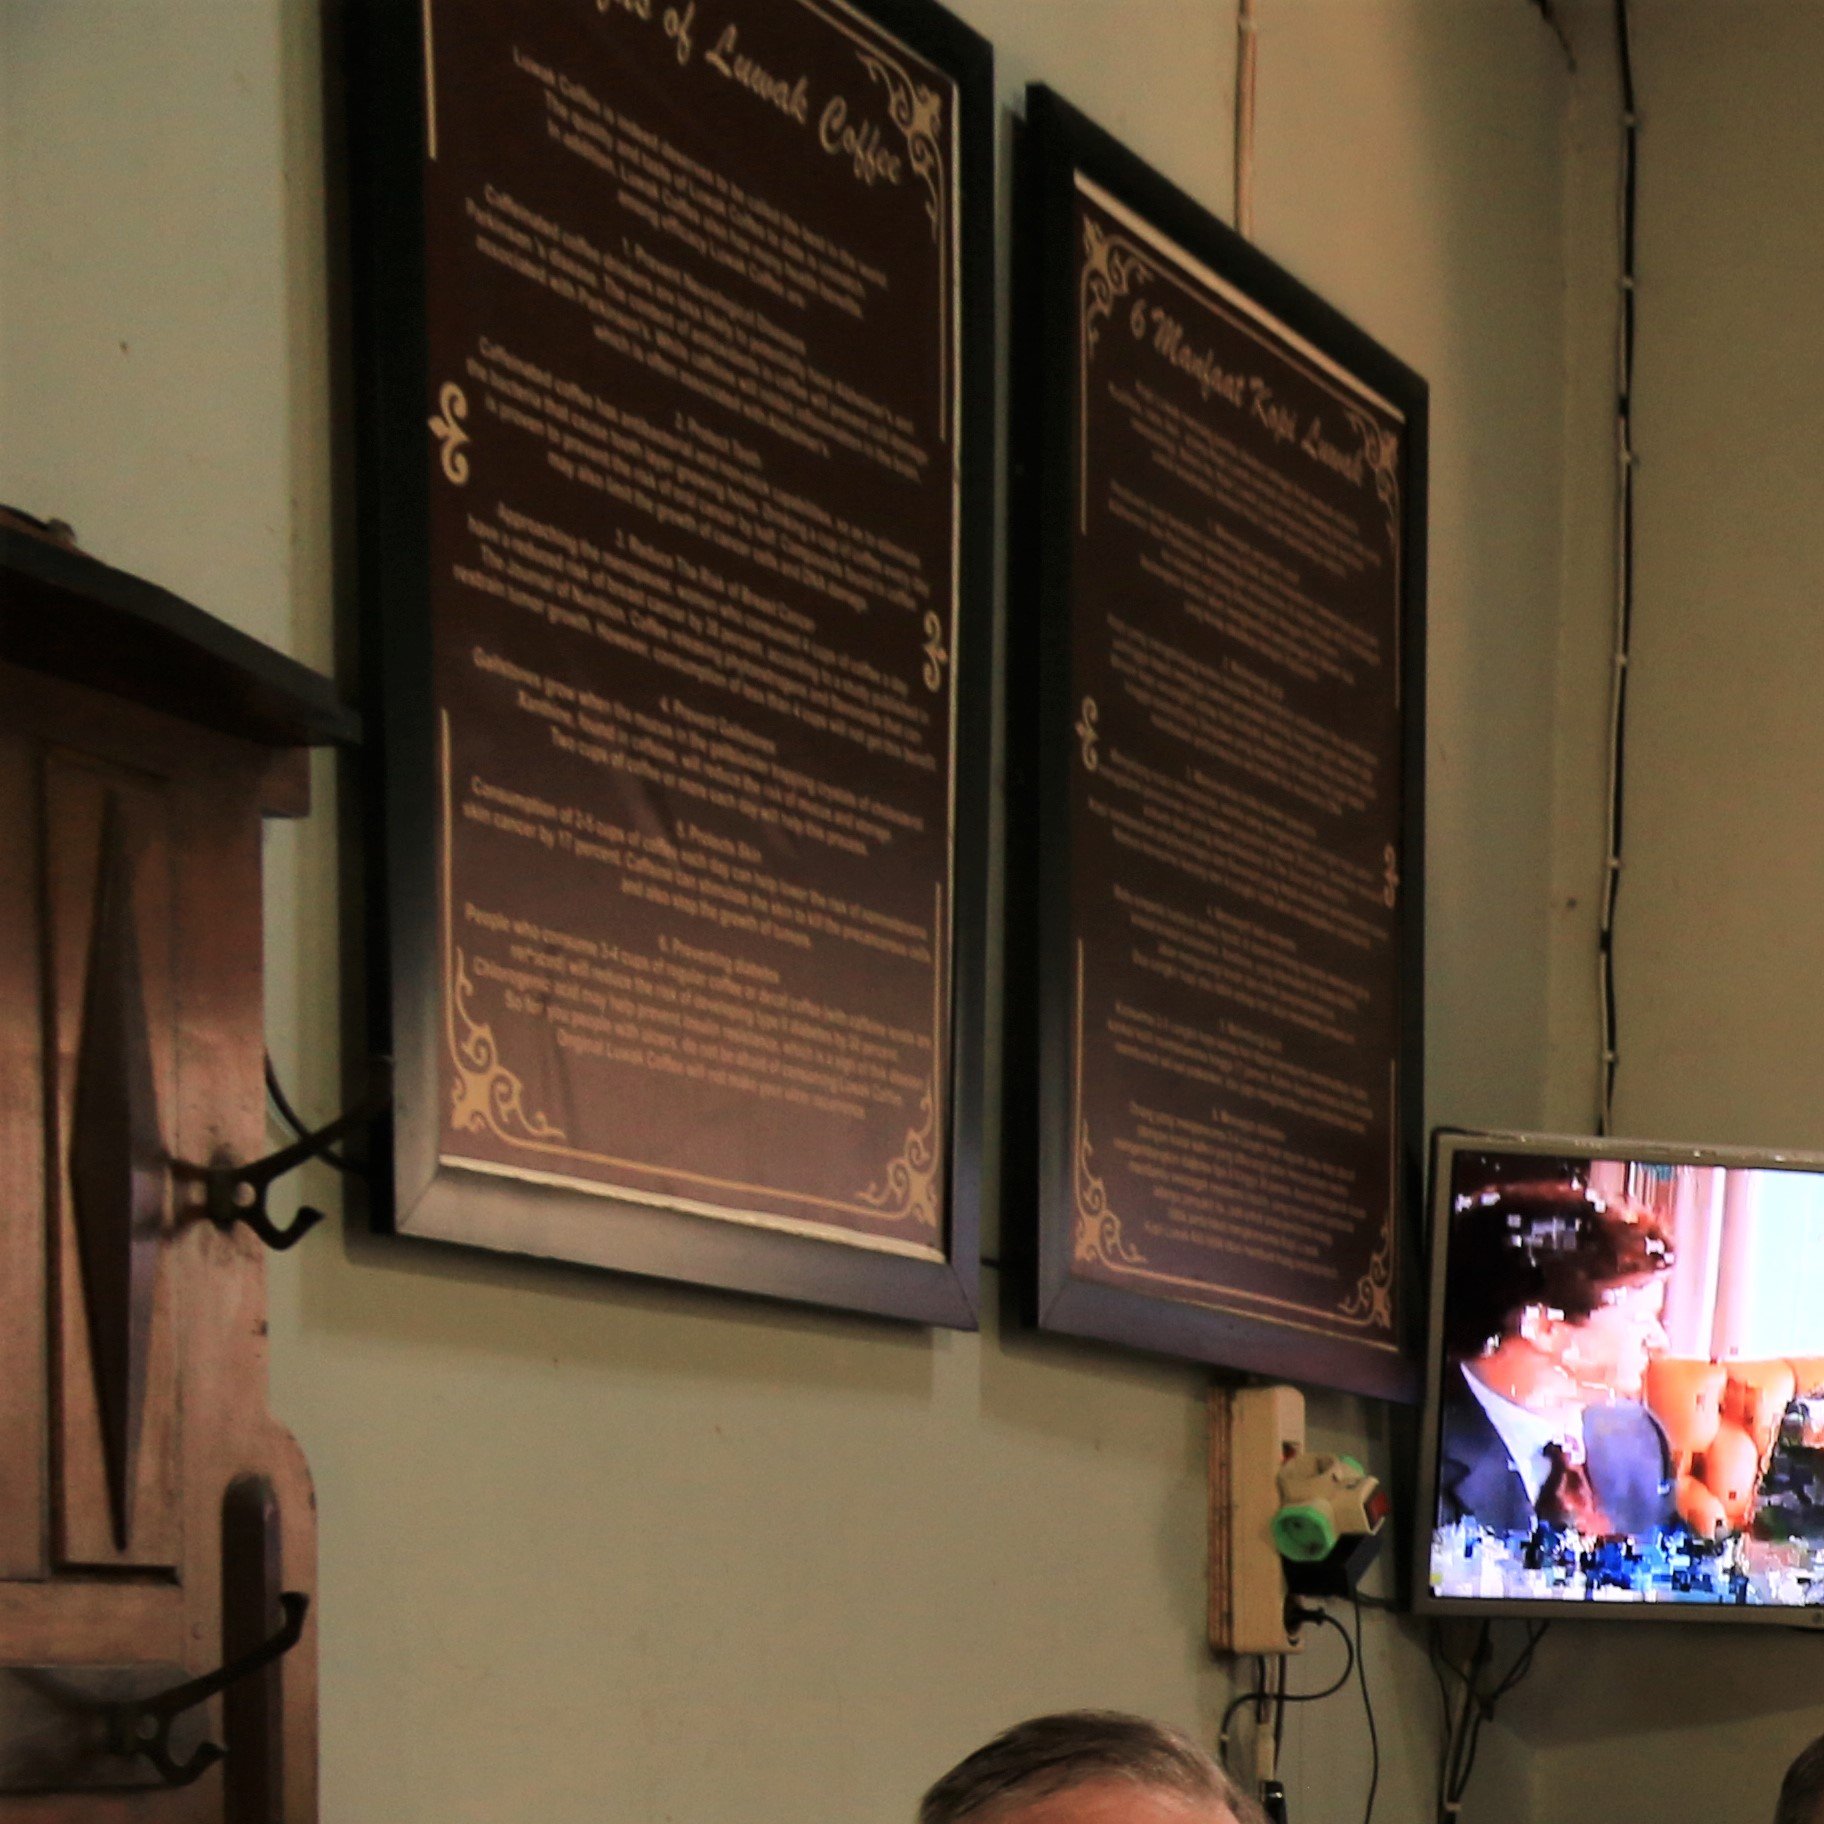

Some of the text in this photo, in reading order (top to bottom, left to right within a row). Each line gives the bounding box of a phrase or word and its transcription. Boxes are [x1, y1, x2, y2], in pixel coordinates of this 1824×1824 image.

[663, 0, 902, 187] of Luwak Coffee
[1130, 299, 1148, 341] 6
